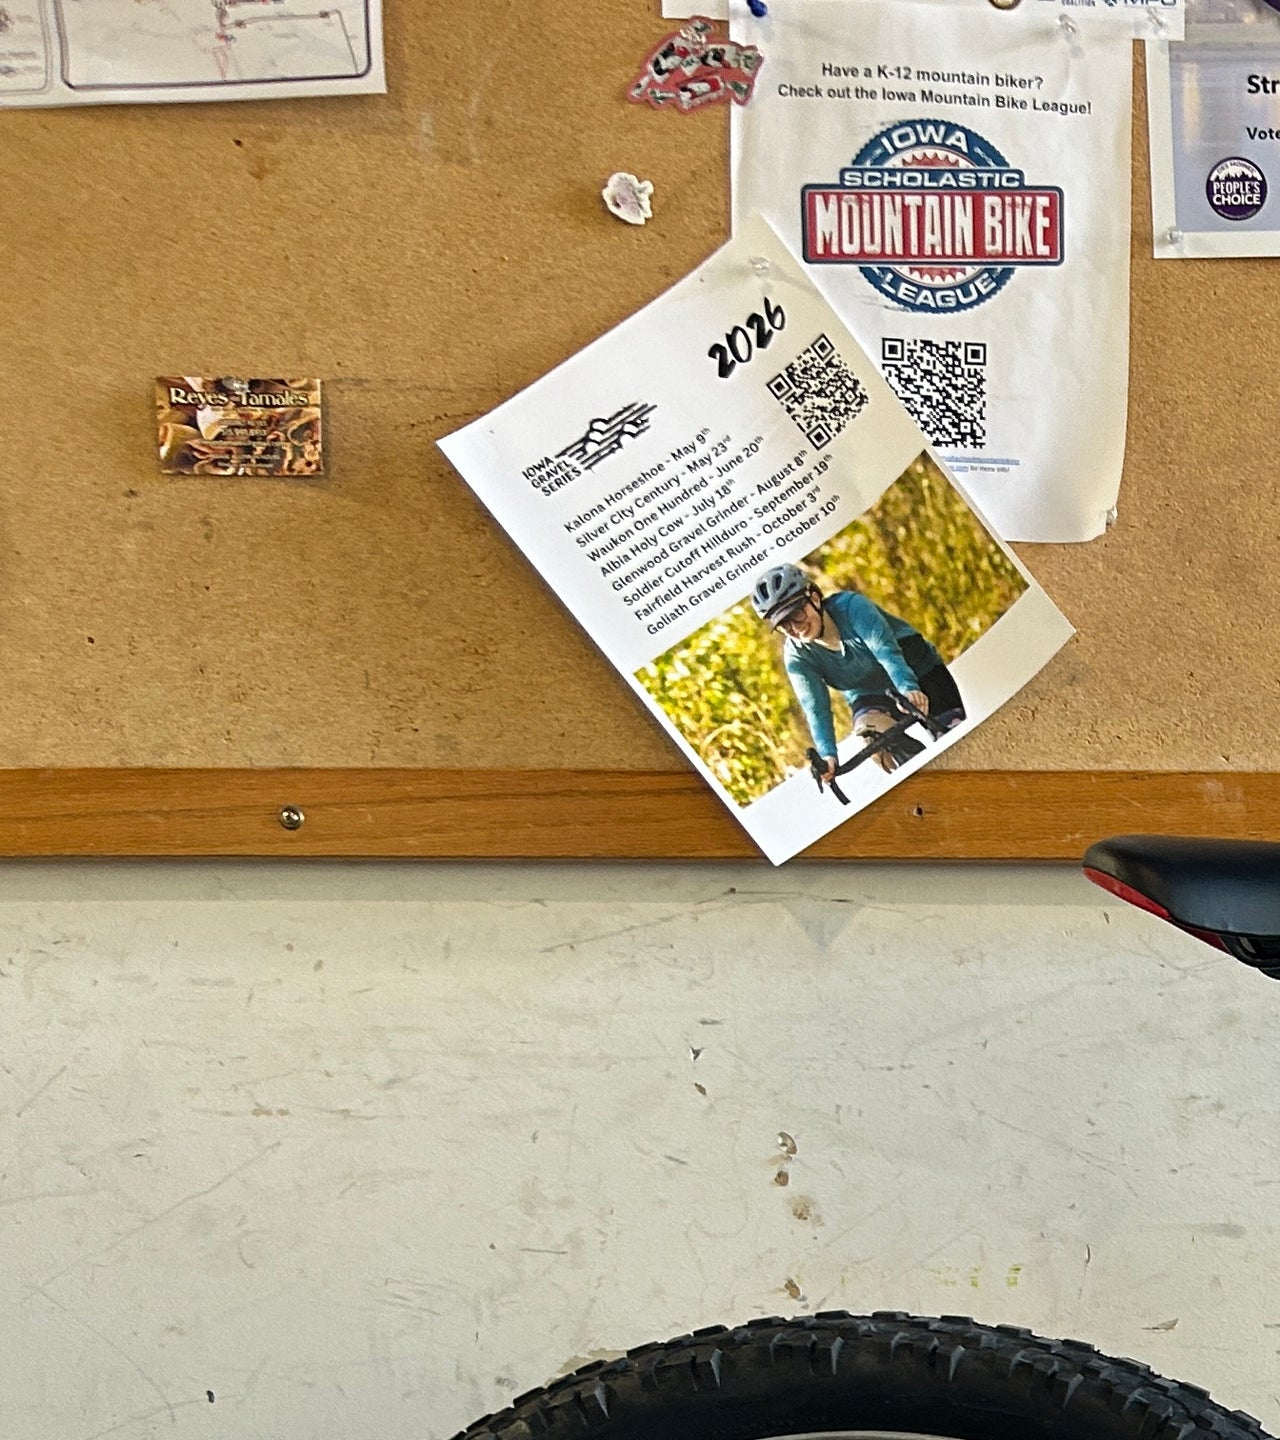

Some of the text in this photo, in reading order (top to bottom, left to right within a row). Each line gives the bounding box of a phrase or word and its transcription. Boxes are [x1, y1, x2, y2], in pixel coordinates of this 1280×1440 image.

[822, 63, 1043, 90] Have a K-12 mountain biker?
[778, 84, 1092, 116] Check out the Iowa Mountain Bike League!
[880, 124, 969, 155] IOWA
[843, 171, 1021, 188] SCHOLASTIC
[1213, 181, 1260, 194] PEOPLE'S
[1213, 194, 1261, 205] CHOICE
[814, 194, 1050, 257] MOUNTAIN BIKE
[881, 272, 997, 308] LEAGUE
[707, 296, 786, 379] 2026
[169, 387, 309, 410] Reyes Tamales
[521, 456, 555, 481] IOWA
[530, 459, 573, 489] GRAVEL
[541, 466, 582, 497] SERIES
[563, 504, 606, 533] Kalona
[603, 463, 666, 507] Horseshoe
[670, 441, 697, 462] May
[575, 522, 610, 548] Silver
[609, 505, 635, 525] City
[634, 474, 681, 509] Century
[686, 453, 713, 474] May
[586, 529, 635, 562] Waukon
[633, 512, 659, 531] One
[657, 476, 709, 515] Hundred
[716, 454, 744, 478] June
[600, 554, 632, 578] Albia
[628, 534, 659, 557] Holy
[657, 517, 684, 537] Cow
[691, 495, 716, 517] July
[611, 547, 670, 592] Glenwood
[668, 523, 708, 553] Gravel
[705, 496, 749, 528] Grinder
[756, 463, 797, 496] August
[623, 575, 665, 607] Soldier
[664, 548, 702, 578] Cutoff
[700, 520, 748, 554] Hillduro
[753, 471, 814, 519] September
[634, 583, 683, 621] Fairfield
[680, 554, 728, 589] Harvest
[725, 536, 757, 559] Rush
[762, 499, 808, 534] October
[646, 604, 689, 635] Goliath
[688, 576, 727, 607] Gravel
[725, 549, 769, 581] Grinder
[775, 513, 821, 548] October
